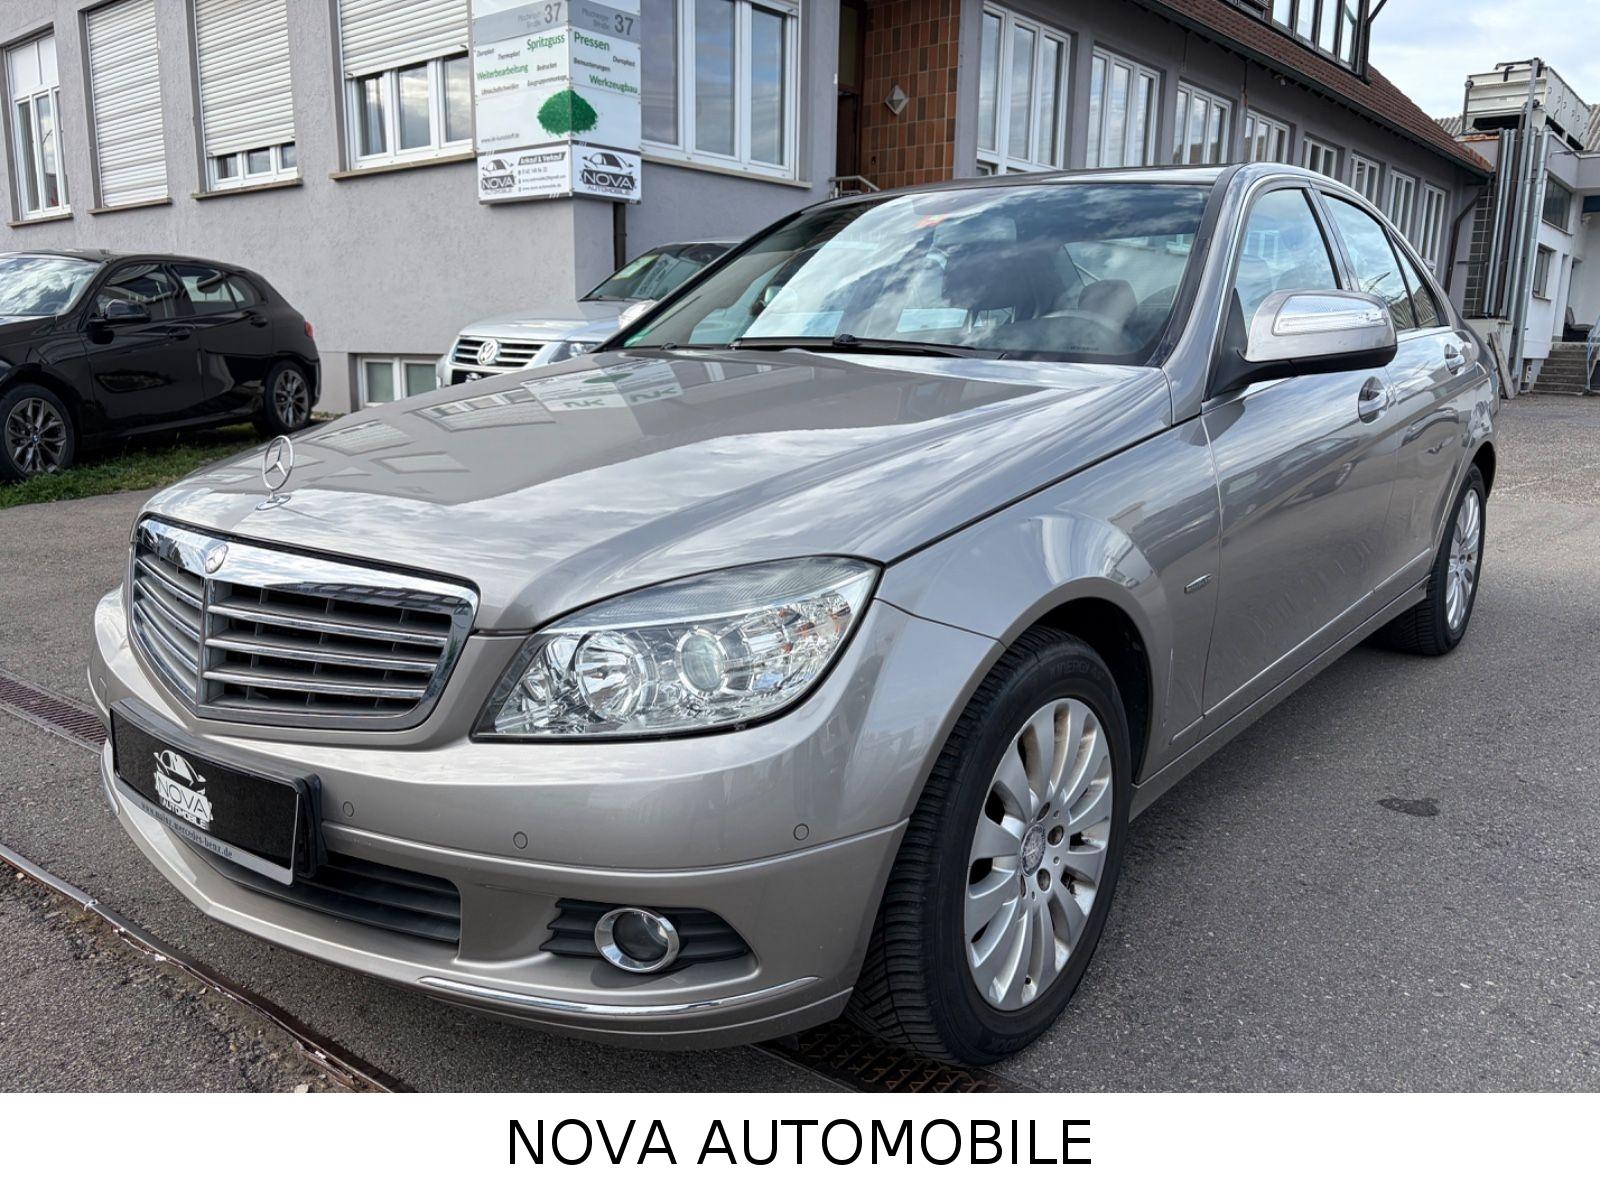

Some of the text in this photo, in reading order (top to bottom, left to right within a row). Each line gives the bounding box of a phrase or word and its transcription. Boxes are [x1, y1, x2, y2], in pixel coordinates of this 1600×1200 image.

[544, 2, 561, 24] 37
[614, 14, 633, 35] 37
[527, 33, 565, 52] Spritzguss
[574, 32, 610, 51] Pressen
[589, 74, 638, 94] Werkzeugbau
[482, 174, 515, 190] NOVA
[583, 171, 632, 189] NOVA
[158, 775, 208, 819] NOVA
